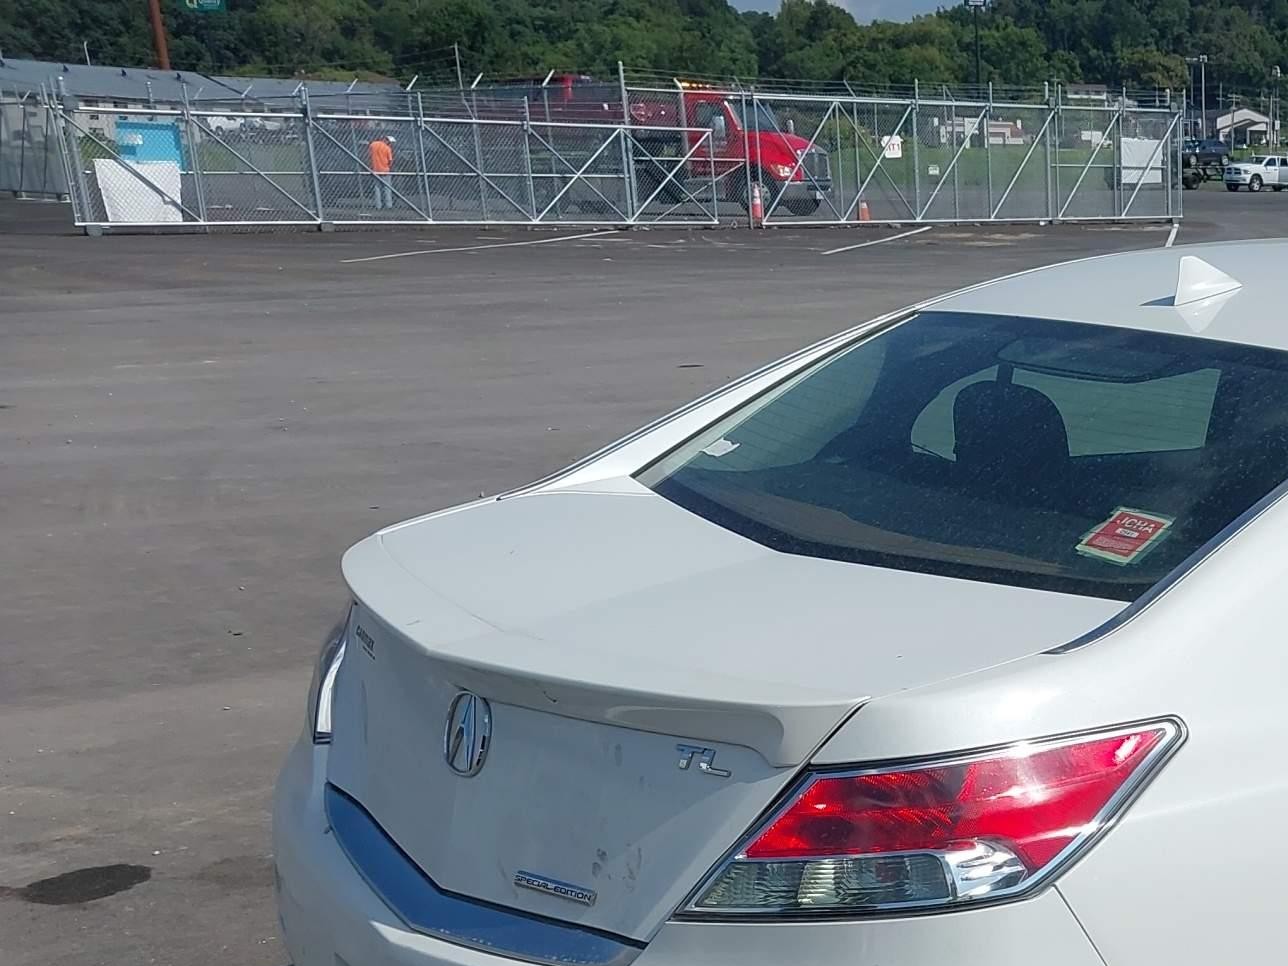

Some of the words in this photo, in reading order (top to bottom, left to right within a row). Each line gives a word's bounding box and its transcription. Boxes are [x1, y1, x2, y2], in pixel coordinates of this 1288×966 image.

[676, 744, 732, 777] TL
[514, 874, 554, 890] SPECIAL
[553, 885, 592, 901] EDITION
